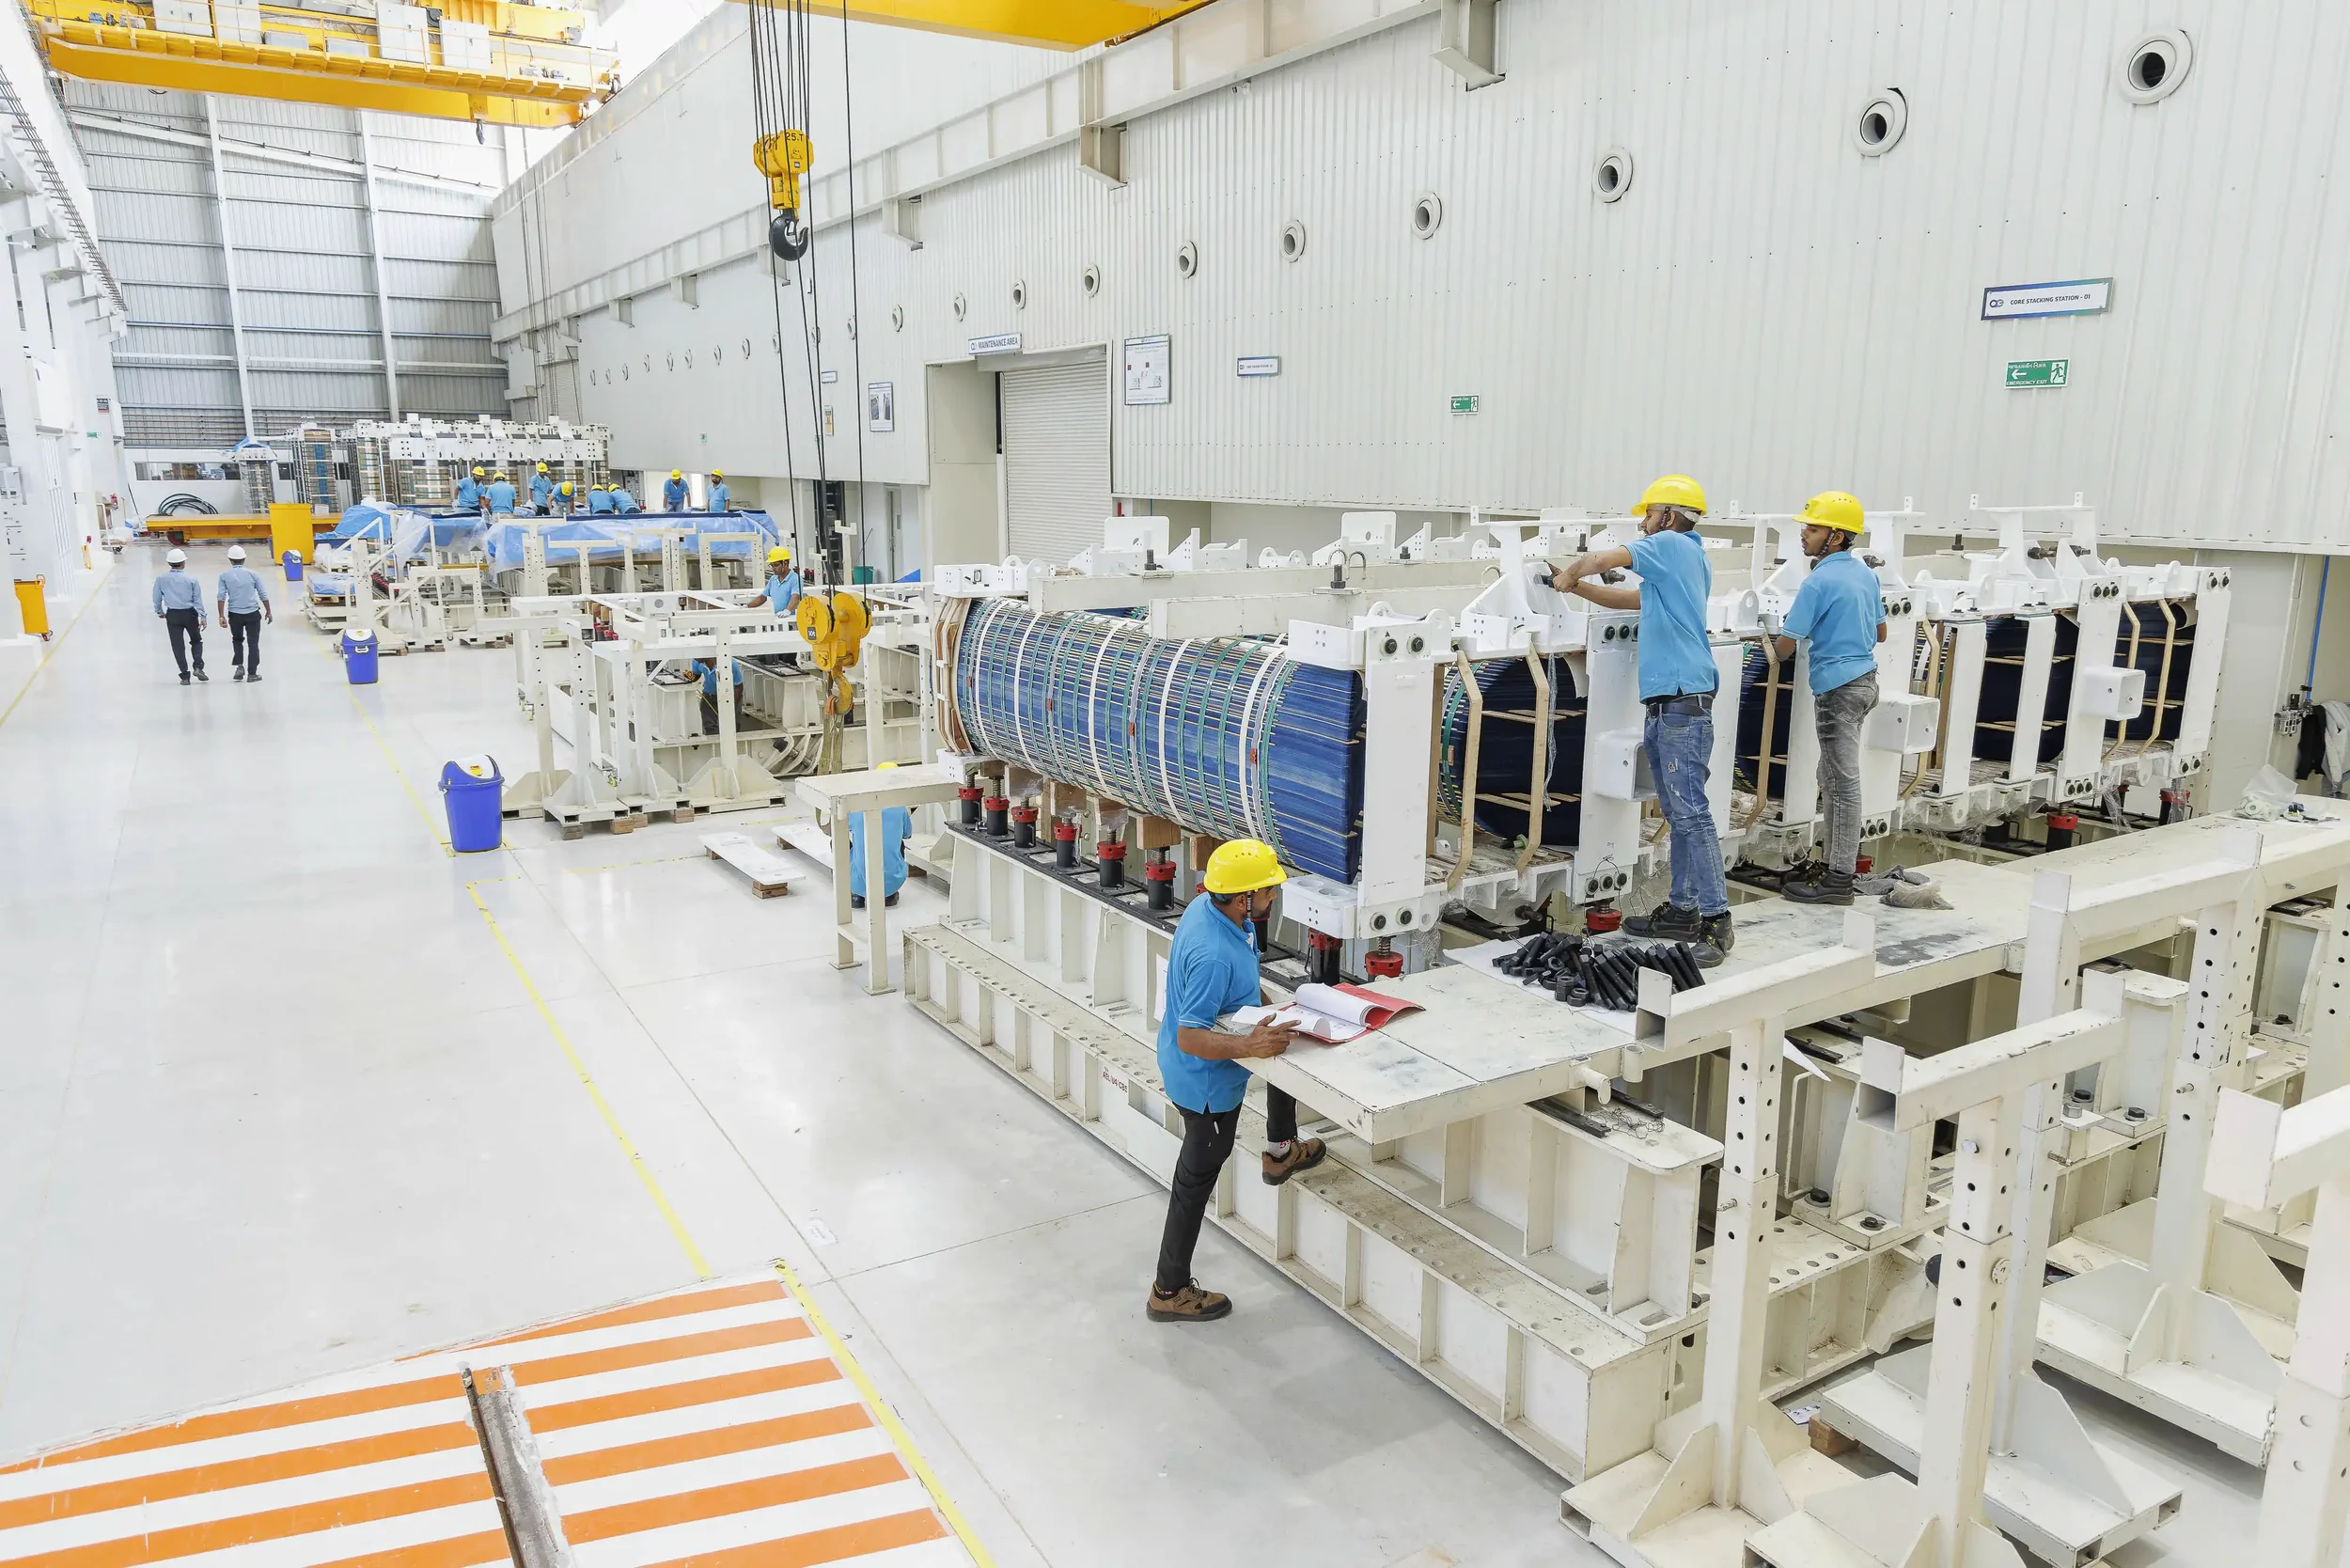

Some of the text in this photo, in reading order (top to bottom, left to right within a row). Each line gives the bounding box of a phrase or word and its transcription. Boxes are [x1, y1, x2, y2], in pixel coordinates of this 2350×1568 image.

[2055, 294, 2079, 303] STATION
[978, 337, 1007, 349] MAINTENANCE
[1007, 337, 1018, 346] AREA
